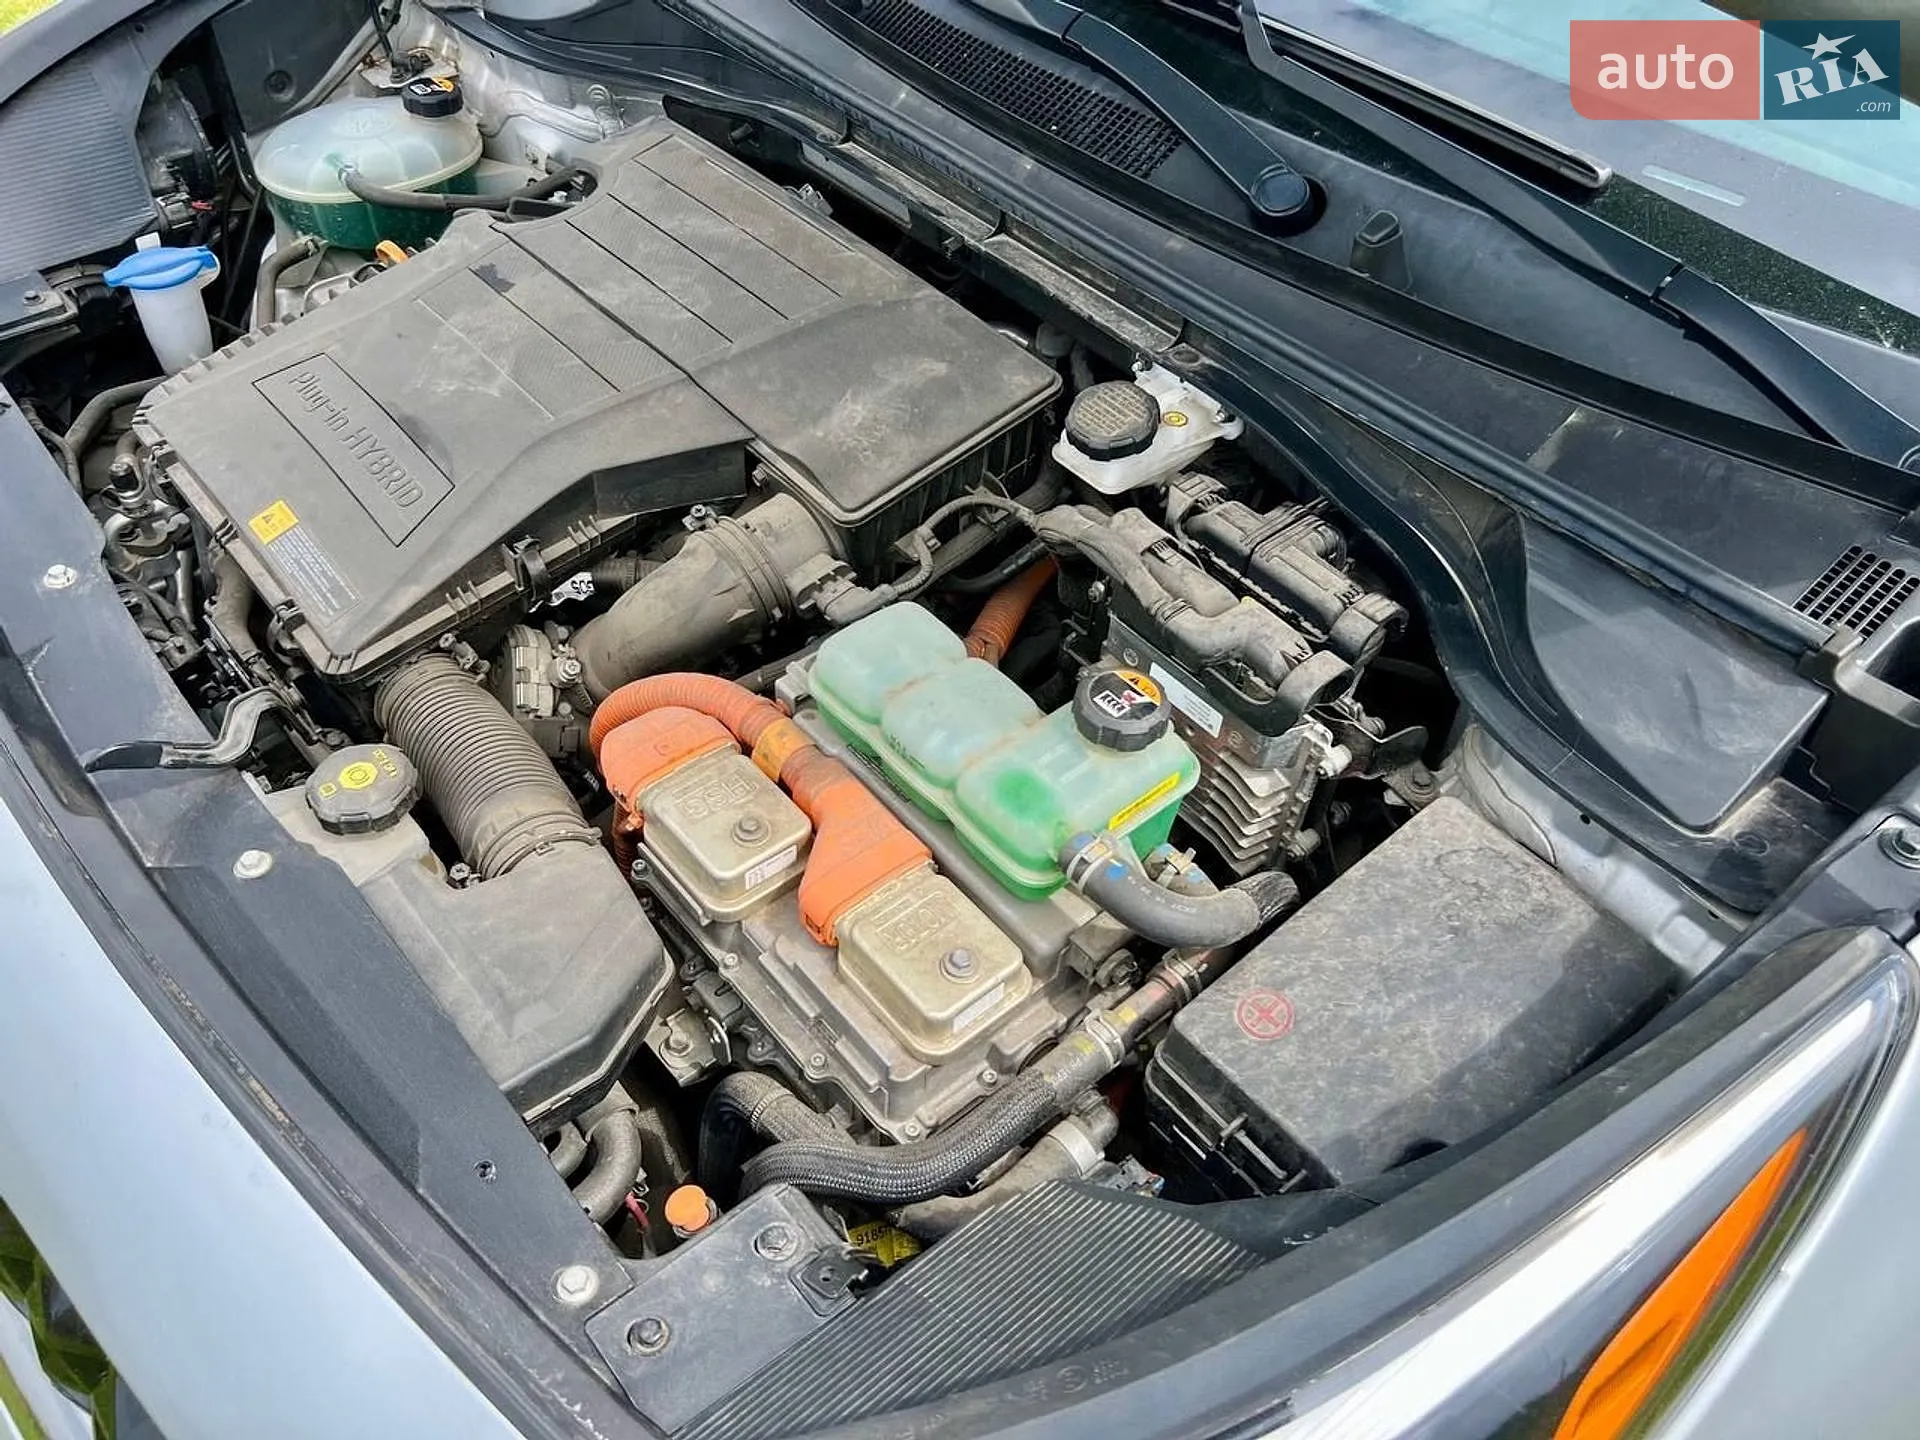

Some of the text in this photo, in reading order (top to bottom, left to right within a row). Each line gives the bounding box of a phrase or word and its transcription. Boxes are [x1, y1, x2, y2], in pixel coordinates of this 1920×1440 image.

[288, 371, 424, 508] Plug-in HYBRID
[679, 768, 757, 818] HSG
